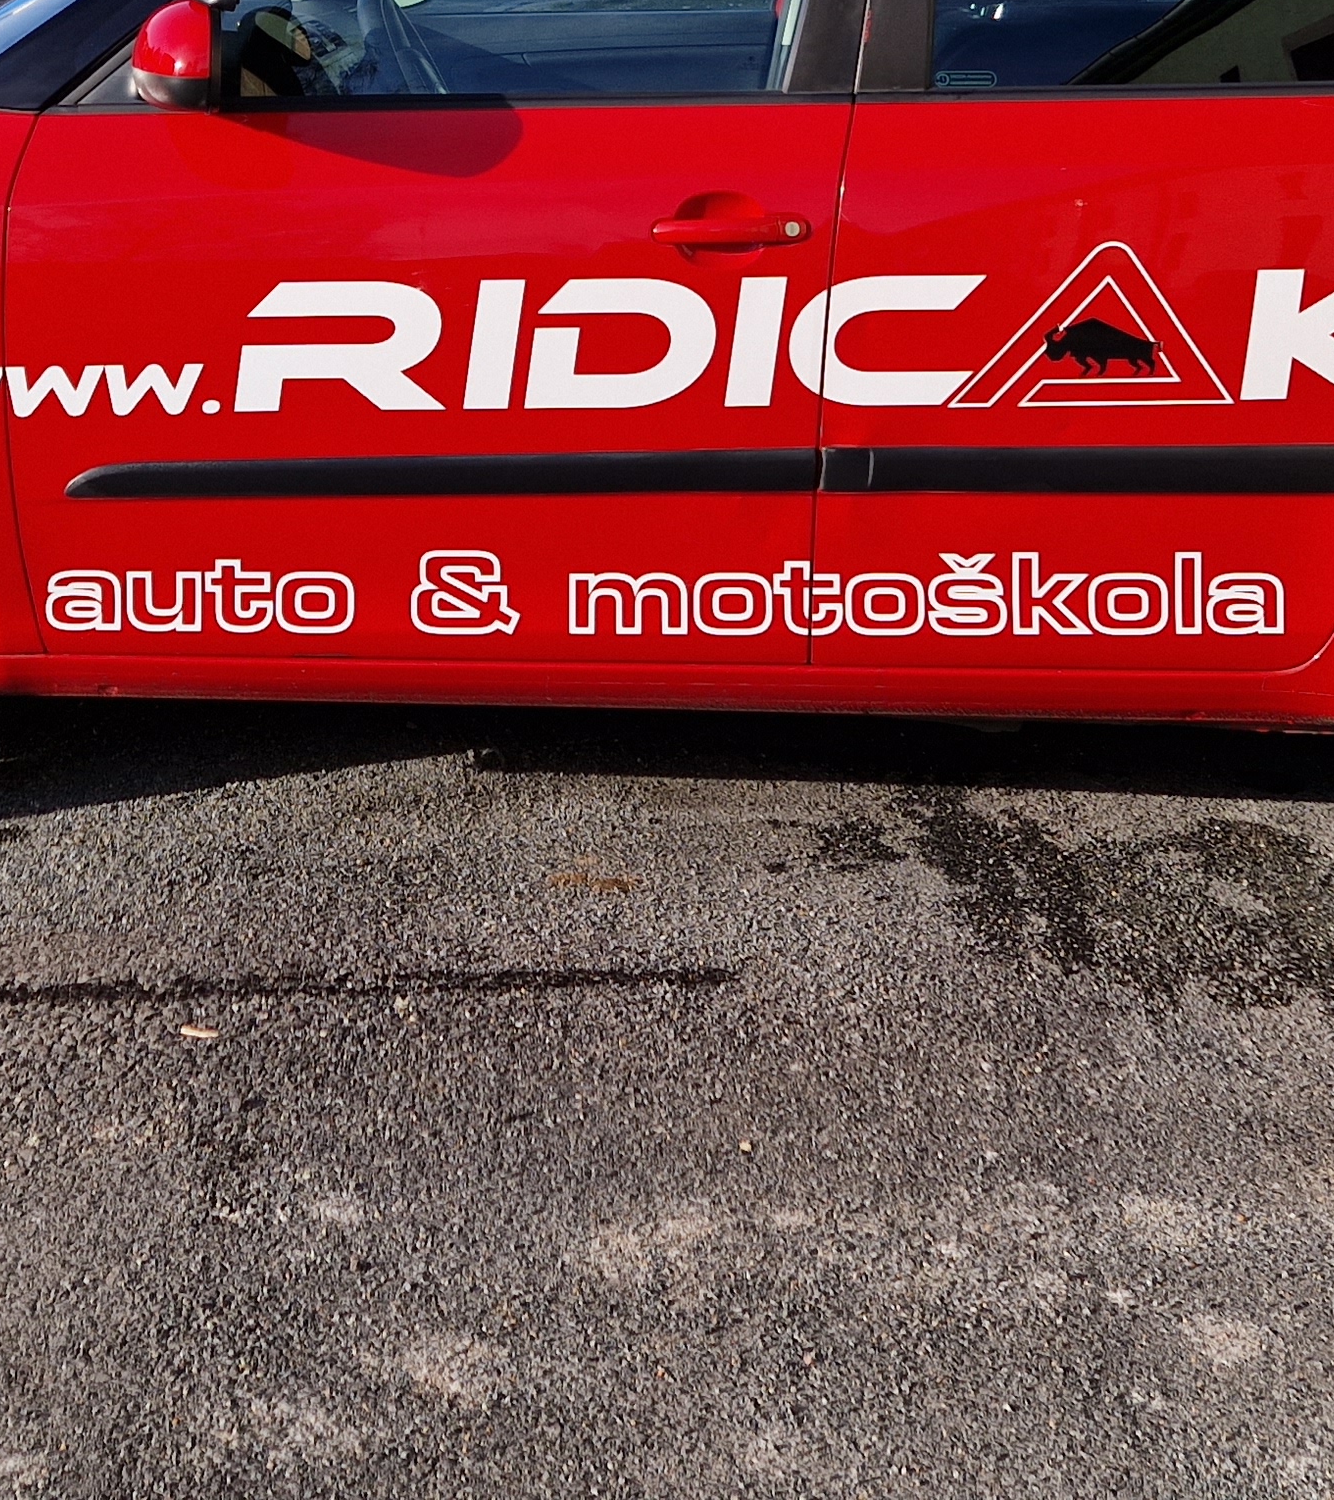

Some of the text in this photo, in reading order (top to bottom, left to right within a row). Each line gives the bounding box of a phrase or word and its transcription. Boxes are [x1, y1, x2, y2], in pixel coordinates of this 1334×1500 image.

[45, 549, 1286, 636] auto & motoškola
